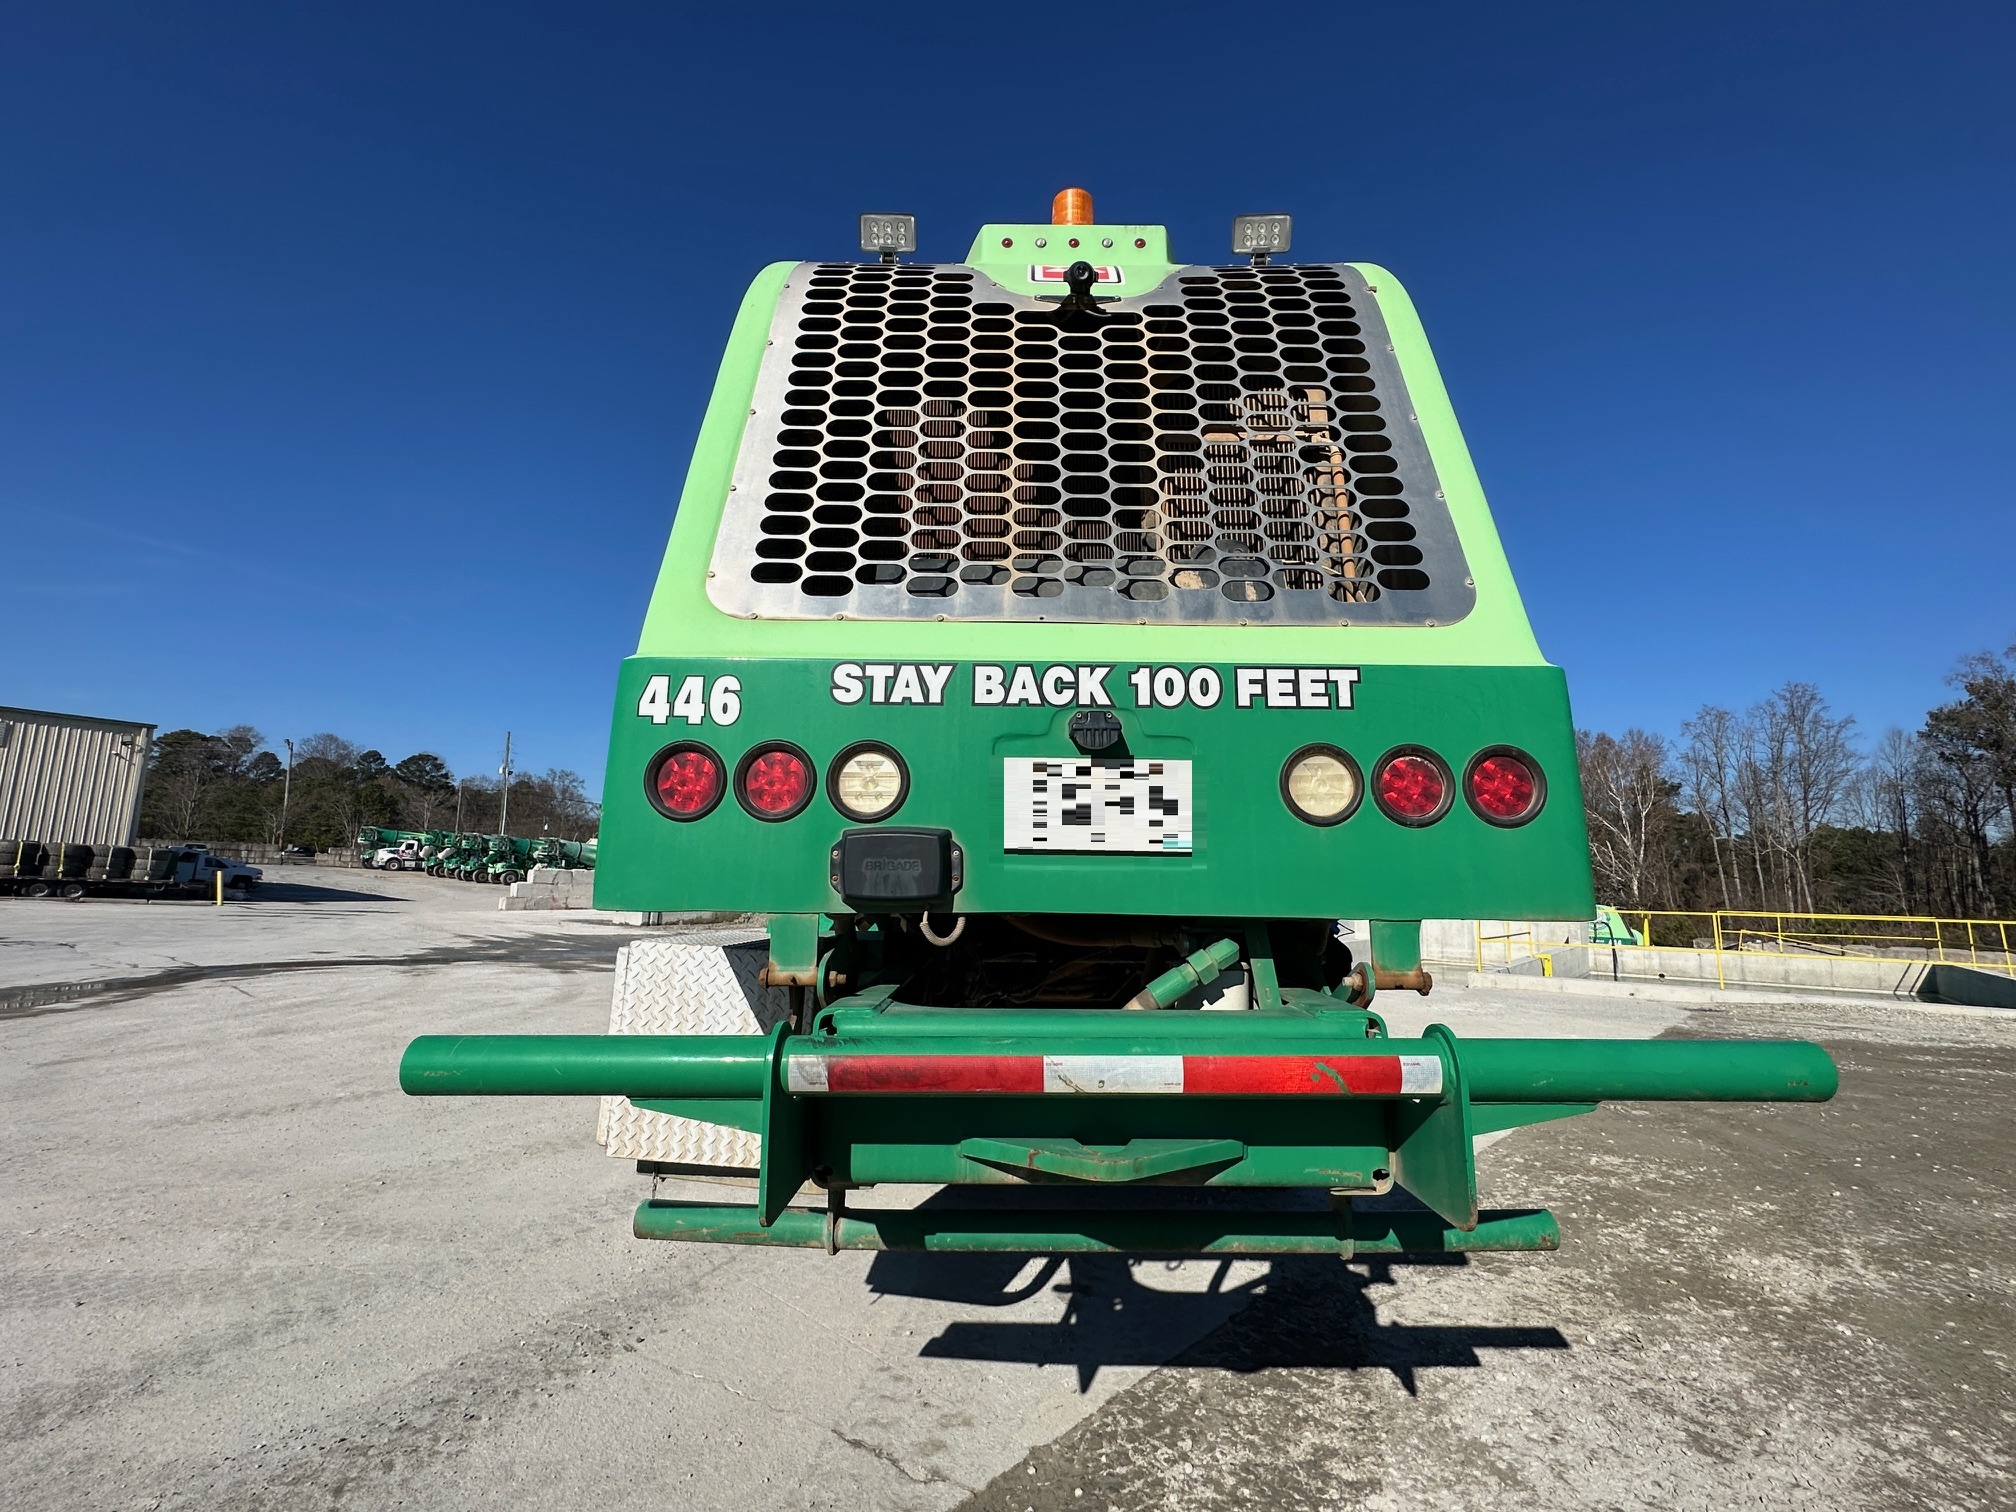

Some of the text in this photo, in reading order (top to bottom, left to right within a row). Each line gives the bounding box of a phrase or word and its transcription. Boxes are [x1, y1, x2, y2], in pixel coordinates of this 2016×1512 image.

[637, 674, 742, 726] 446
[831, 662, 1361, 710] STAY BACK 100 FEET
[865, 858, 922, 872] BRIGADE
